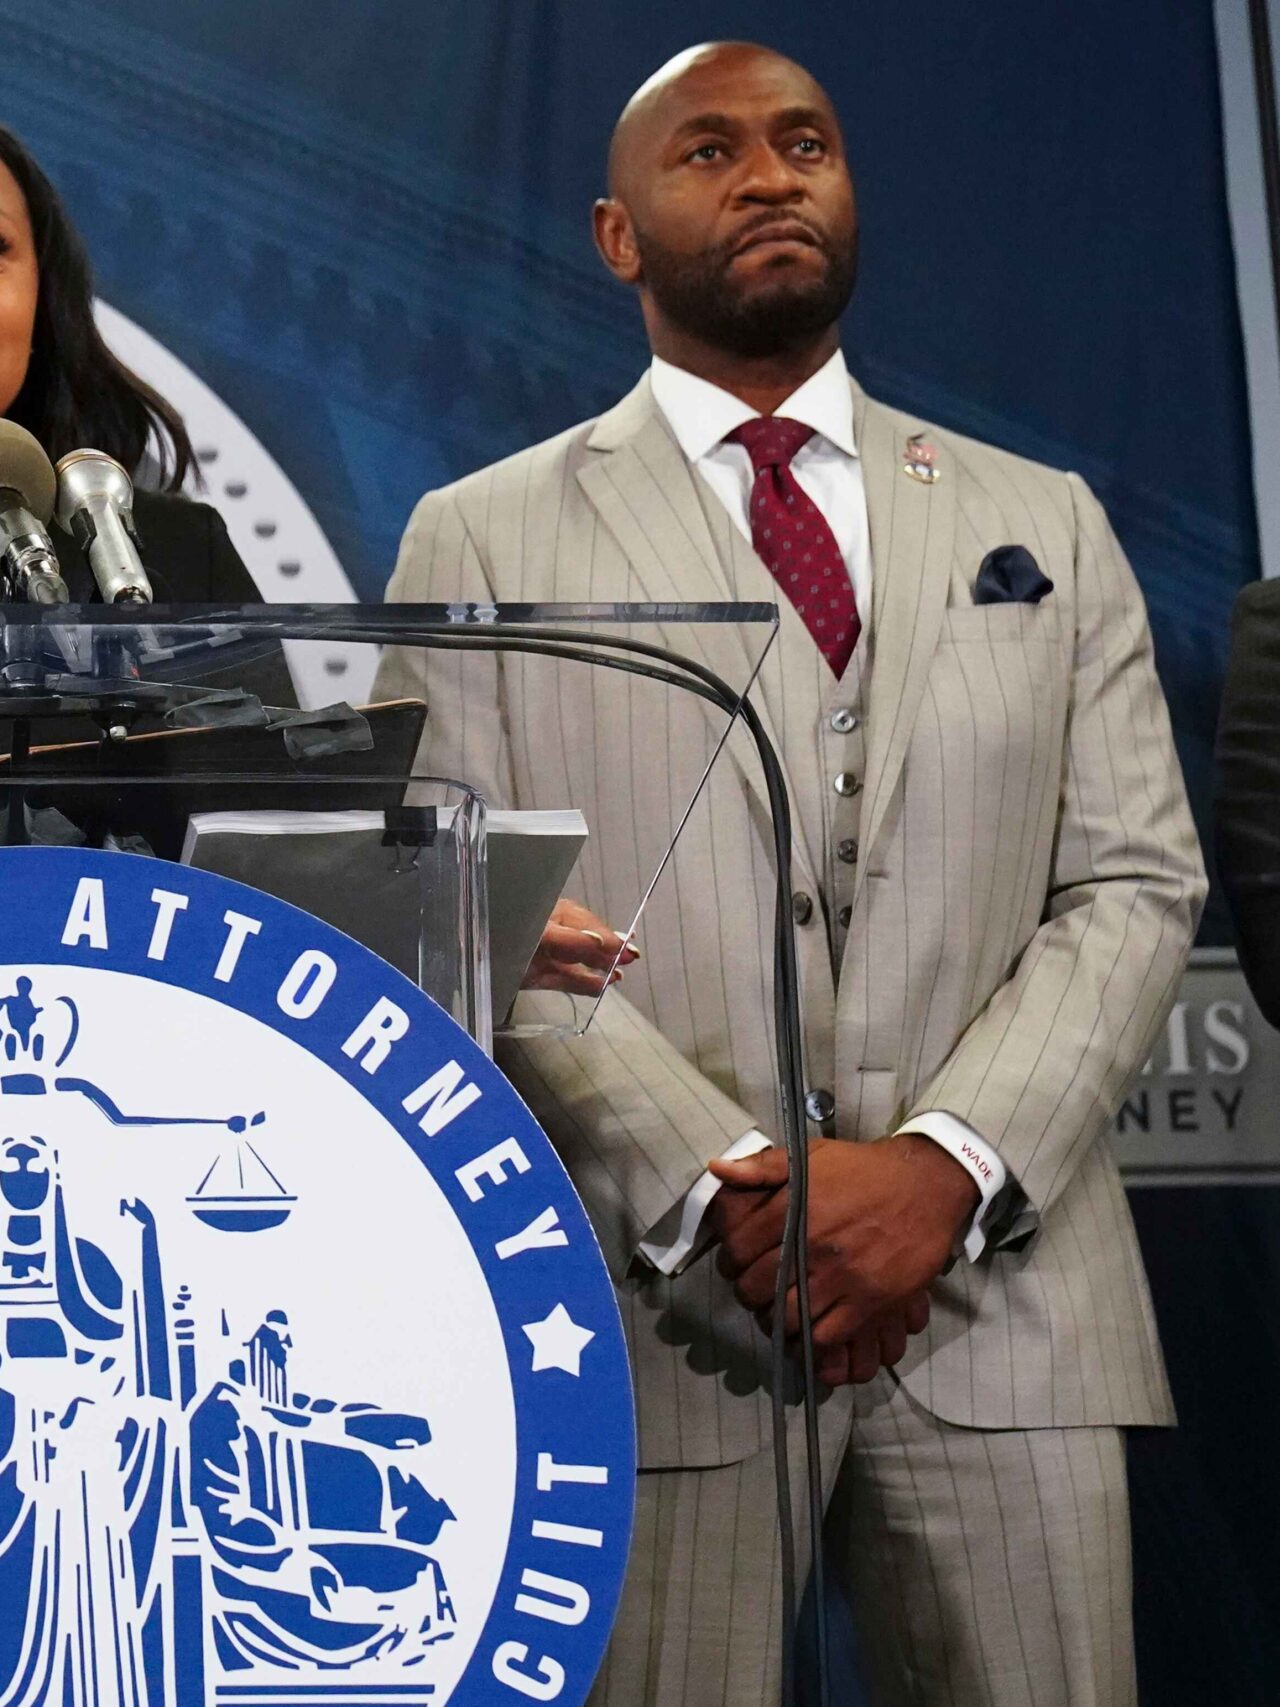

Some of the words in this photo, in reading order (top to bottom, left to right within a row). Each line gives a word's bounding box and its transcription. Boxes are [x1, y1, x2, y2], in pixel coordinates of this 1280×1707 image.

[60, 876, 570, 1261] ATTORNEY
[960, 1143, 995, 1184] WADE
[491, 1451, 609, 1702] CUIT
